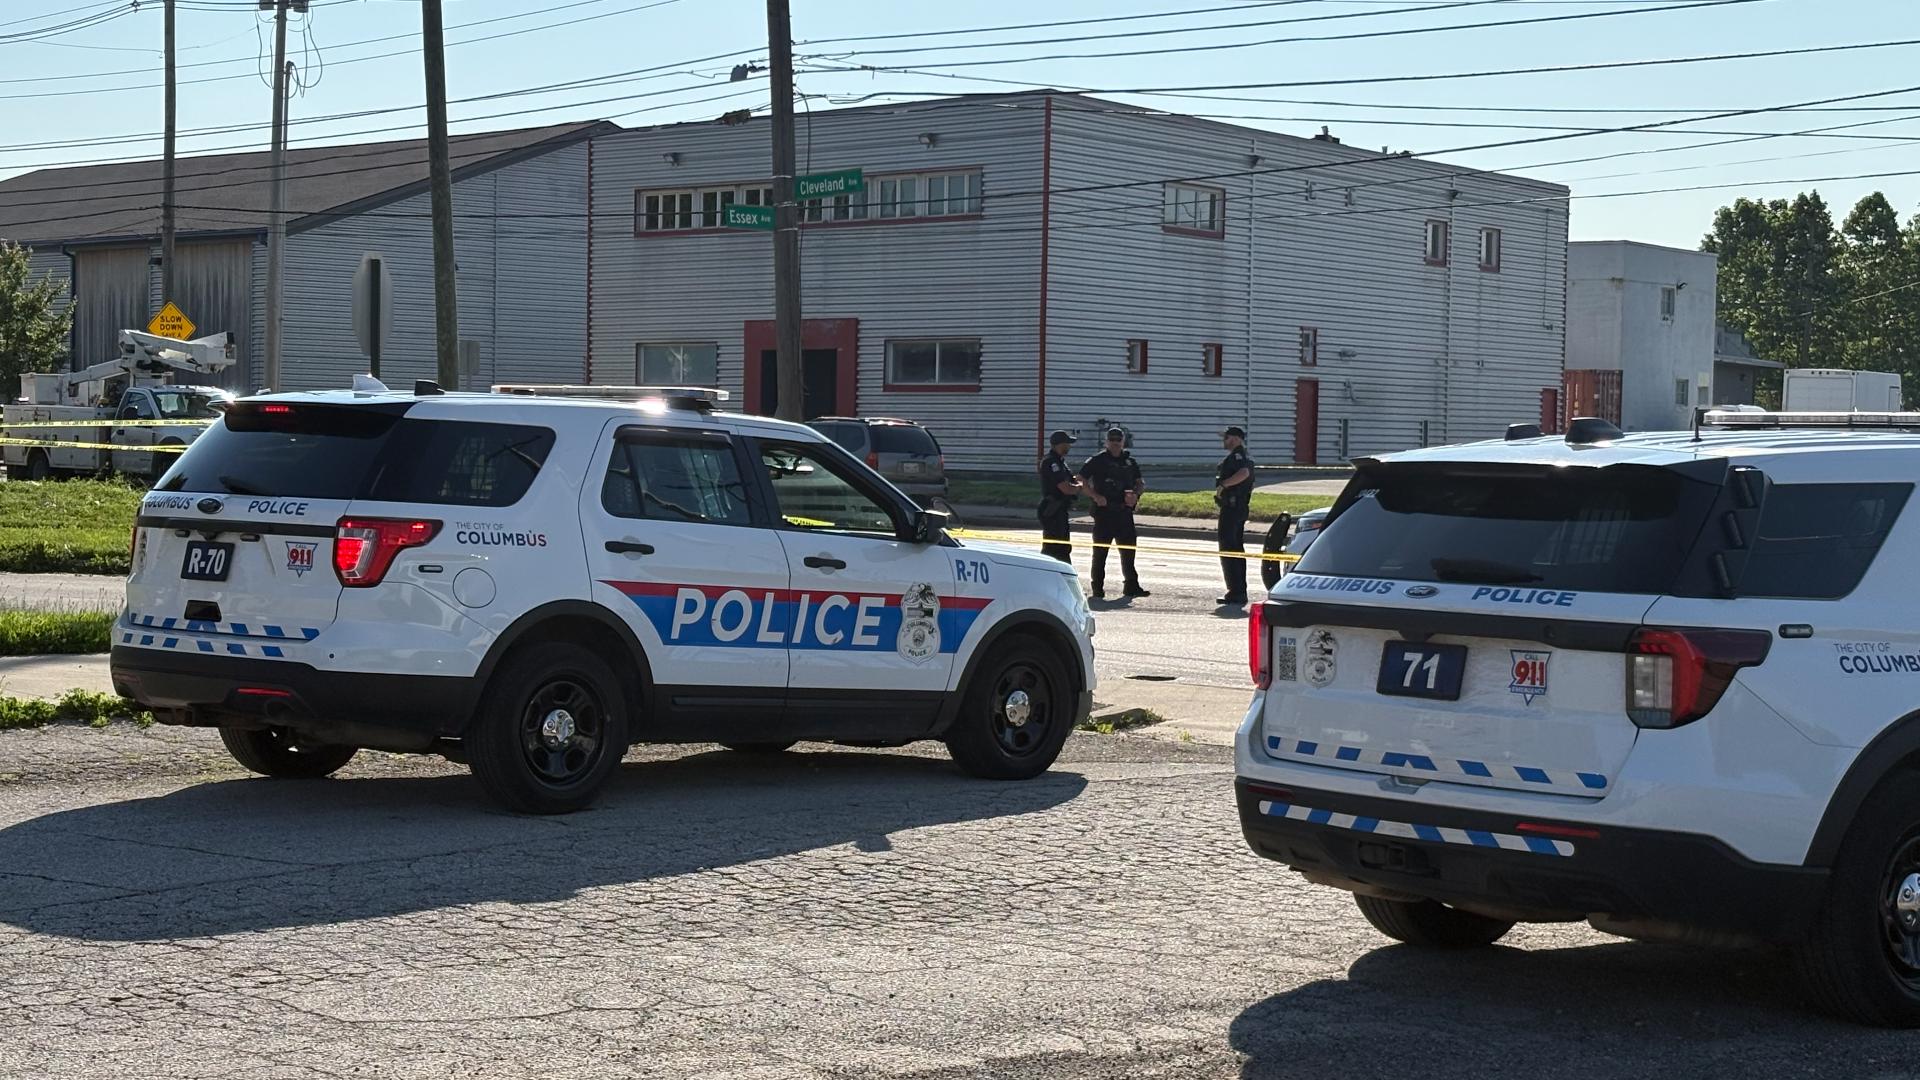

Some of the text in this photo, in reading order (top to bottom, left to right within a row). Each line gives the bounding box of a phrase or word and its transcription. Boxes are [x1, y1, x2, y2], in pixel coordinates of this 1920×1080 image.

[800, 177, 844, 195] Cleveland
[729, 209, 771, 224] Essex Ave
[248, 500, 309, 515] POLICE
[456, 521, 471, 529] THE
[473, 522, 491, 530] CITY
[456, 530, 547, 547] COLUMBUS
[188, 549, 225, 575] R-70
[955, 558, 990, 585] R-70
[1286, 575, 1577, 607] COLUMBUS POLICE
[670, 588, 885, 646] POLICE
[1833, 642, 1891, 653] THE CITY OF
[1402, 652, 1440, 690] 71
[1839, 653, 1920, 674] COLUMB
